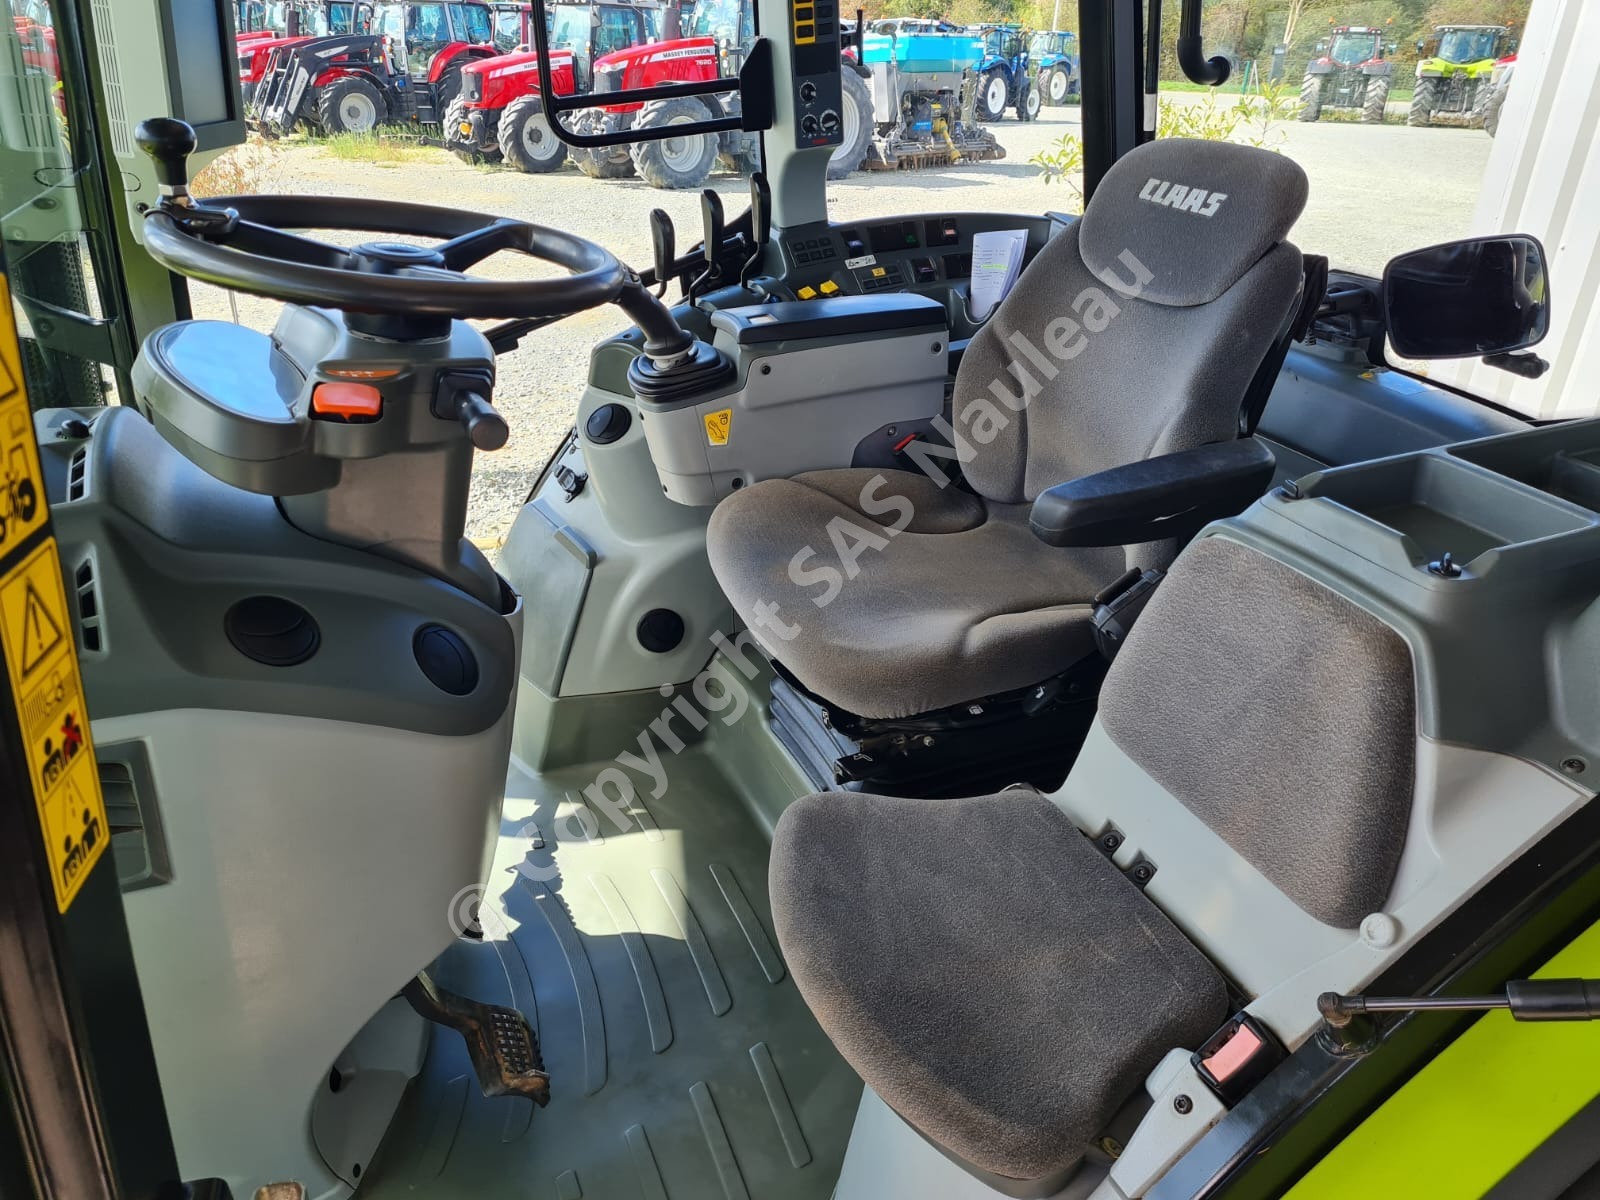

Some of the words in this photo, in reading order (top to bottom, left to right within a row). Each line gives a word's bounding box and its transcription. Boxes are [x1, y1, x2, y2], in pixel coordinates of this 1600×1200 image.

[662, 50, 684, 58] MASSEY
[684, 48, 711, 56] FERGUSON
[1138, 178, 1228, 217] CLAAS
